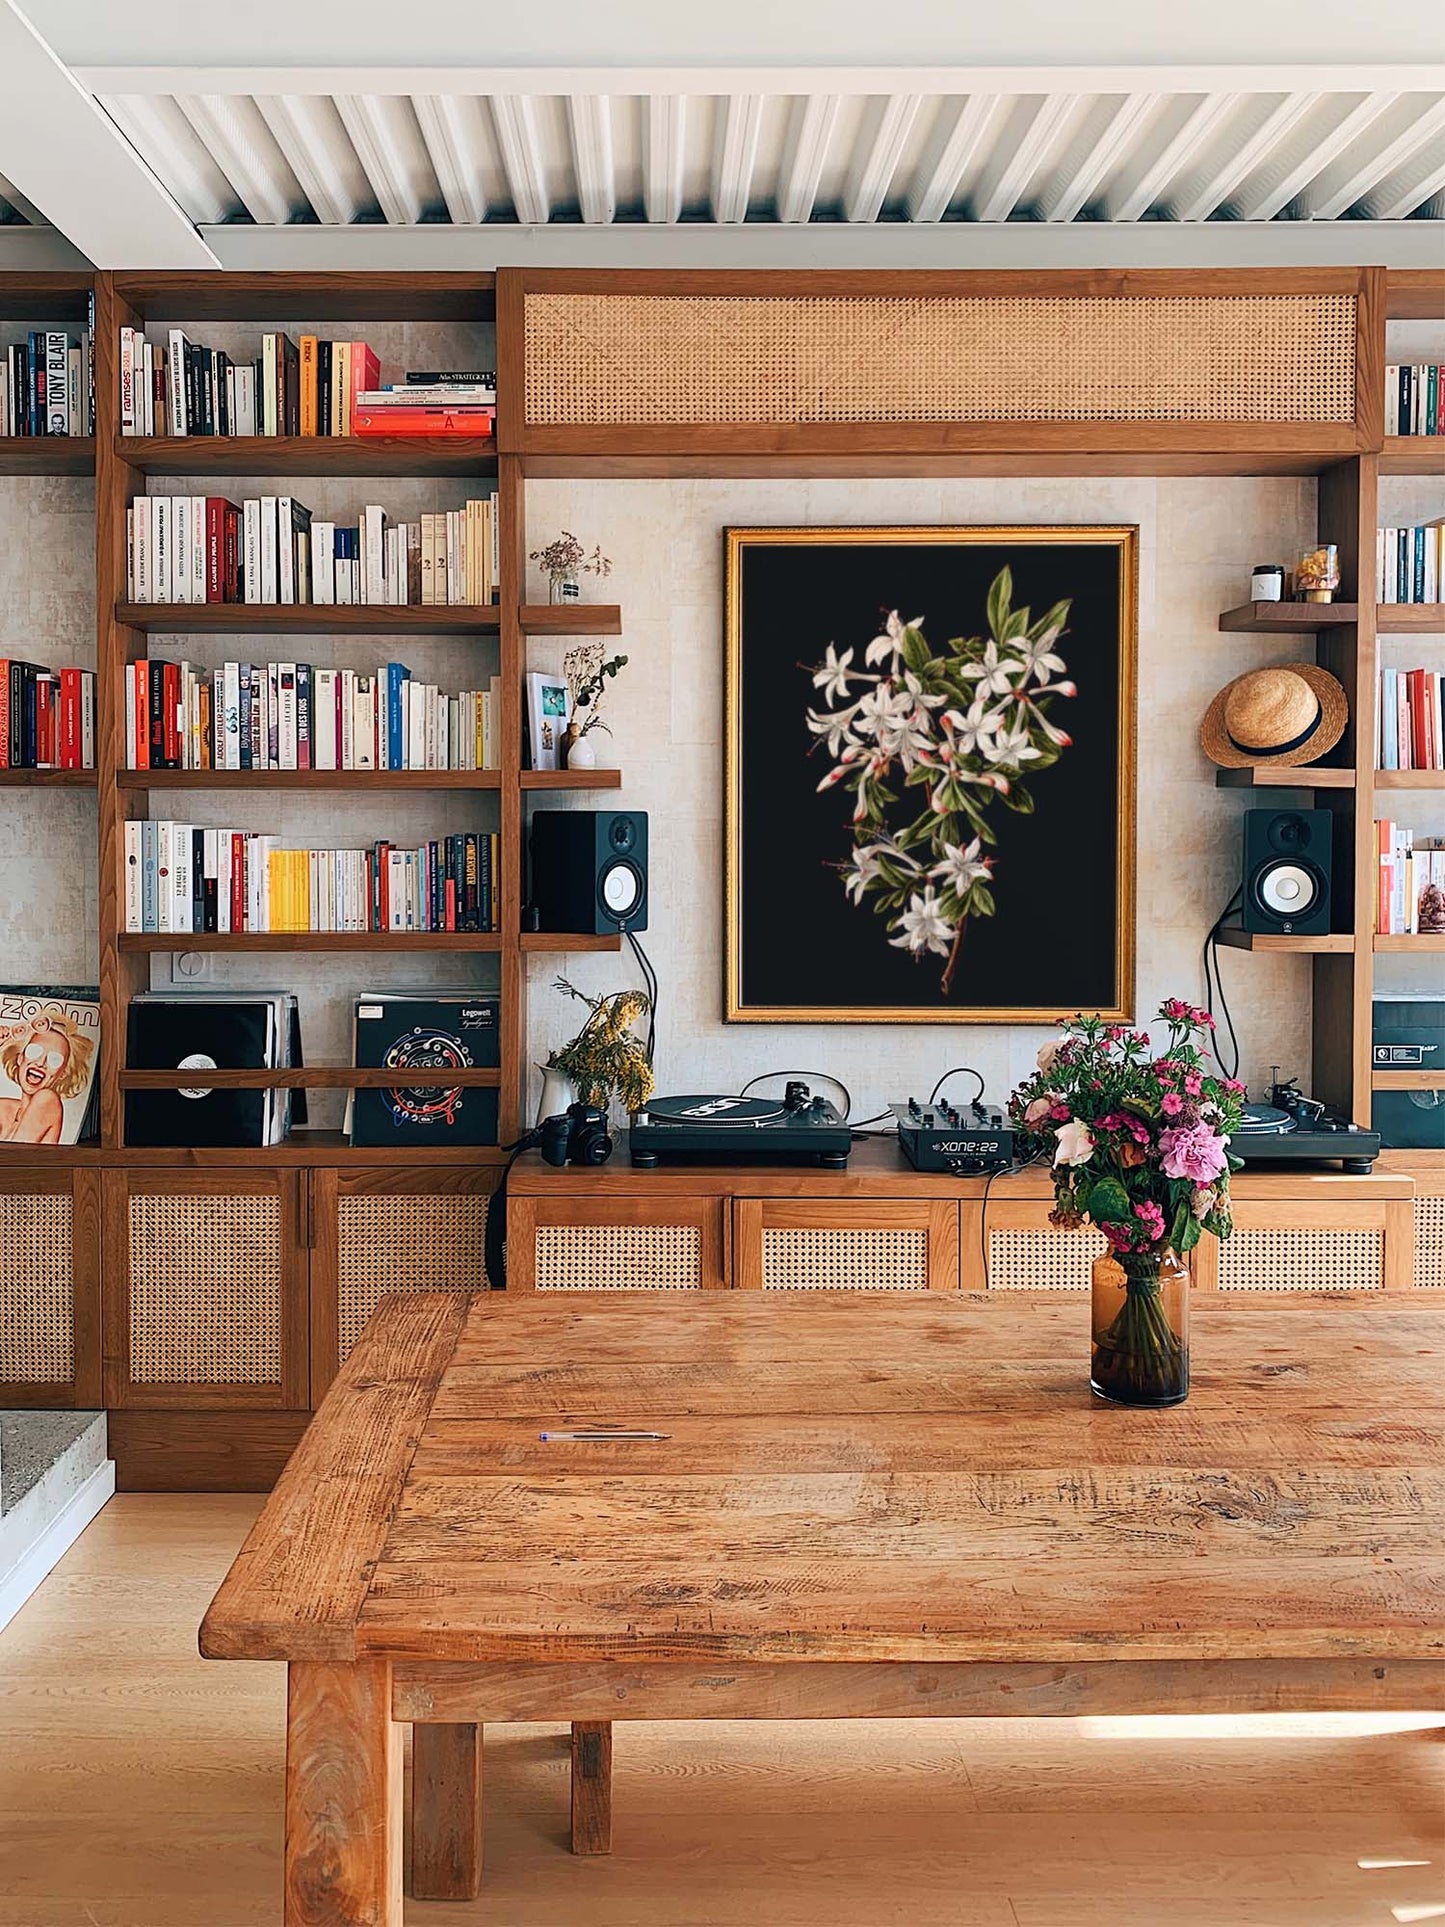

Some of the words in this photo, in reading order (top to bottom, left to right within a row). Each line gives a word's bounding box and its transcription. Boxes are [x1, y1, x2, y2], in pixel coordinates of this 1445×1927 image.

[49, 334, 65, 370] BLAIR
[49, 374, 65, 406] TONY
[123, 371, 131, 412] ramses
[444, 416, 454, 429] A
[211, 557, 217, 565] DU
[240, 698, 249, 726] Masters
[298, 697, 308, 714] FOUS
[216, 714, 224, 737] HITLER
[298, 715, 308, 727] DES
[240, 726, 249, 749] Blythe
[298, 728, 308, 741] L'OR
[216, 739, 224, 760] ADOLF
[466, 844, 476, 885] UNDERCOVER
[940, 1141, 998, 1152] xone:22
